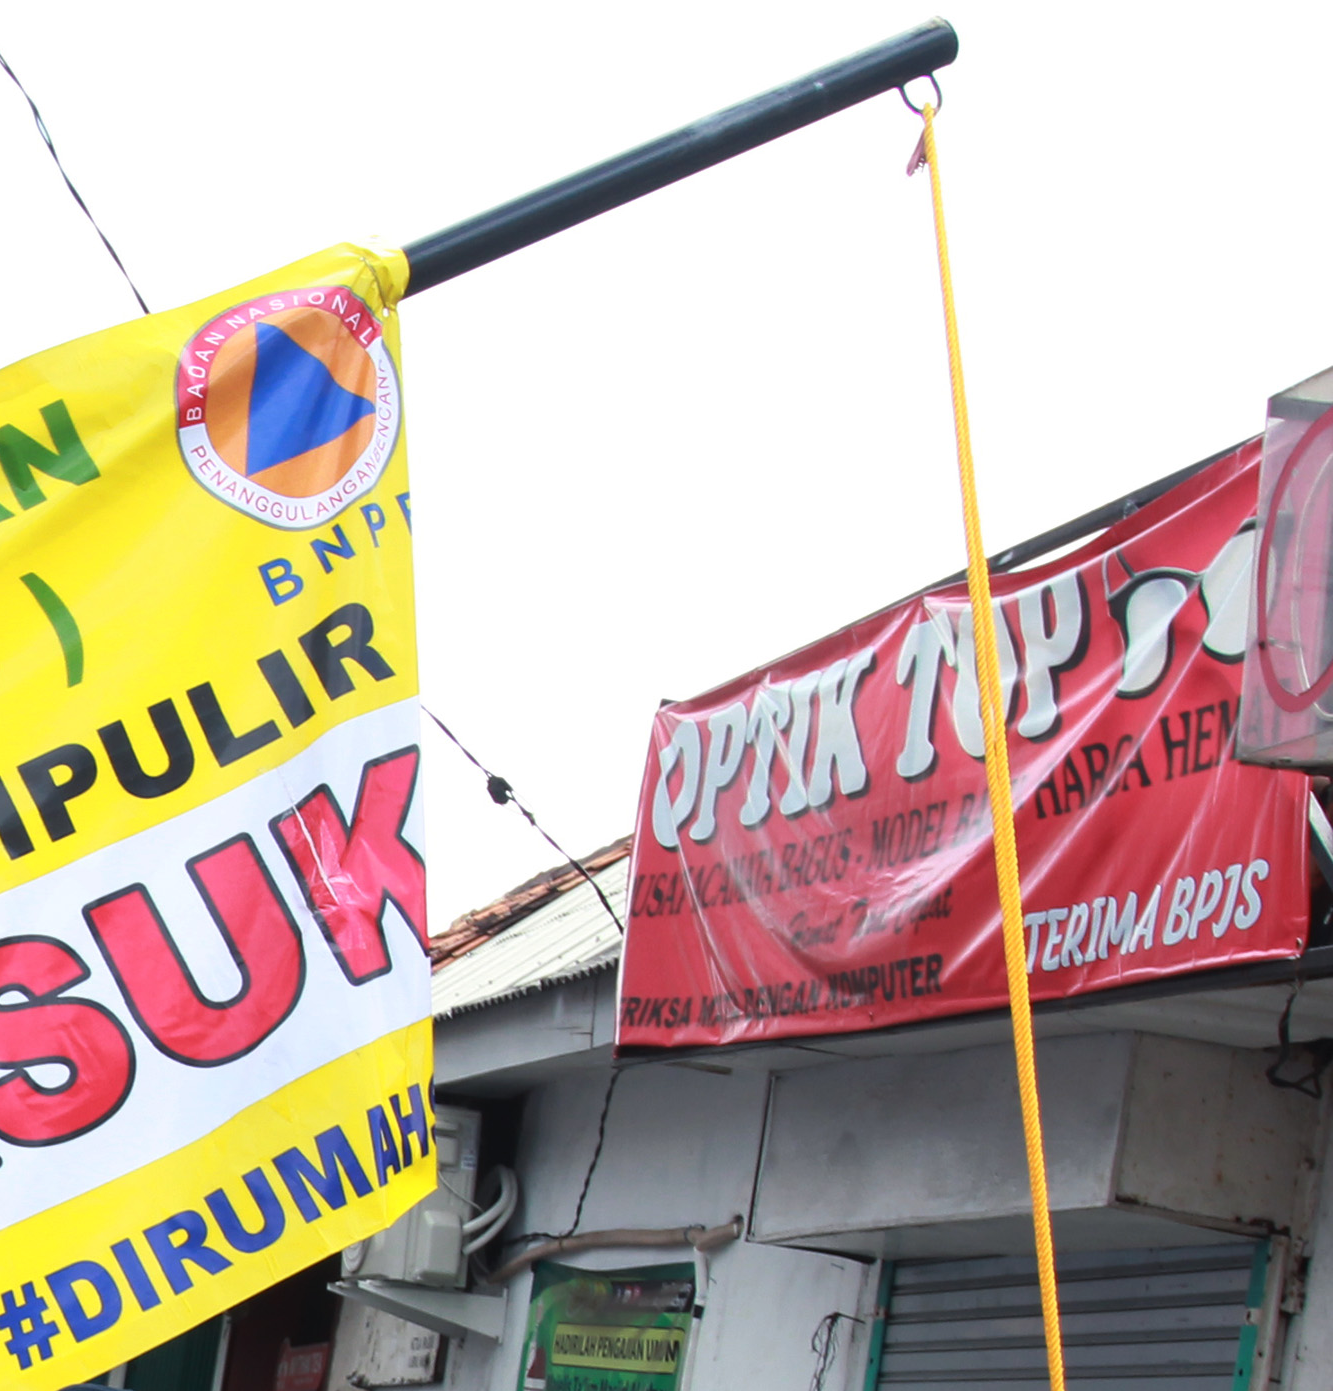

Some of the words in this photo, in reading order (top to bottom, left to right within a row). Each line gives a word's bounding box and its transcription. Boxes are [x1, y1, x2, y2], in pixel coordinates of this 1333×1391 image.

[226, 291, 374, 345] NASIONAL
[20, 572, 85, 687] )
[652, 648, 874, 848] OPTIK
[896, 568, 1085, 778] TOP
[866, 801, 949, 872] MODEL
[1033, 734, 1151, 819] HARGA
[1024, 884, 1162, 974] TERIMA
[1162, 858, 1270, 946] BPJS
[622, 996, 692, 1029] RIKSA
